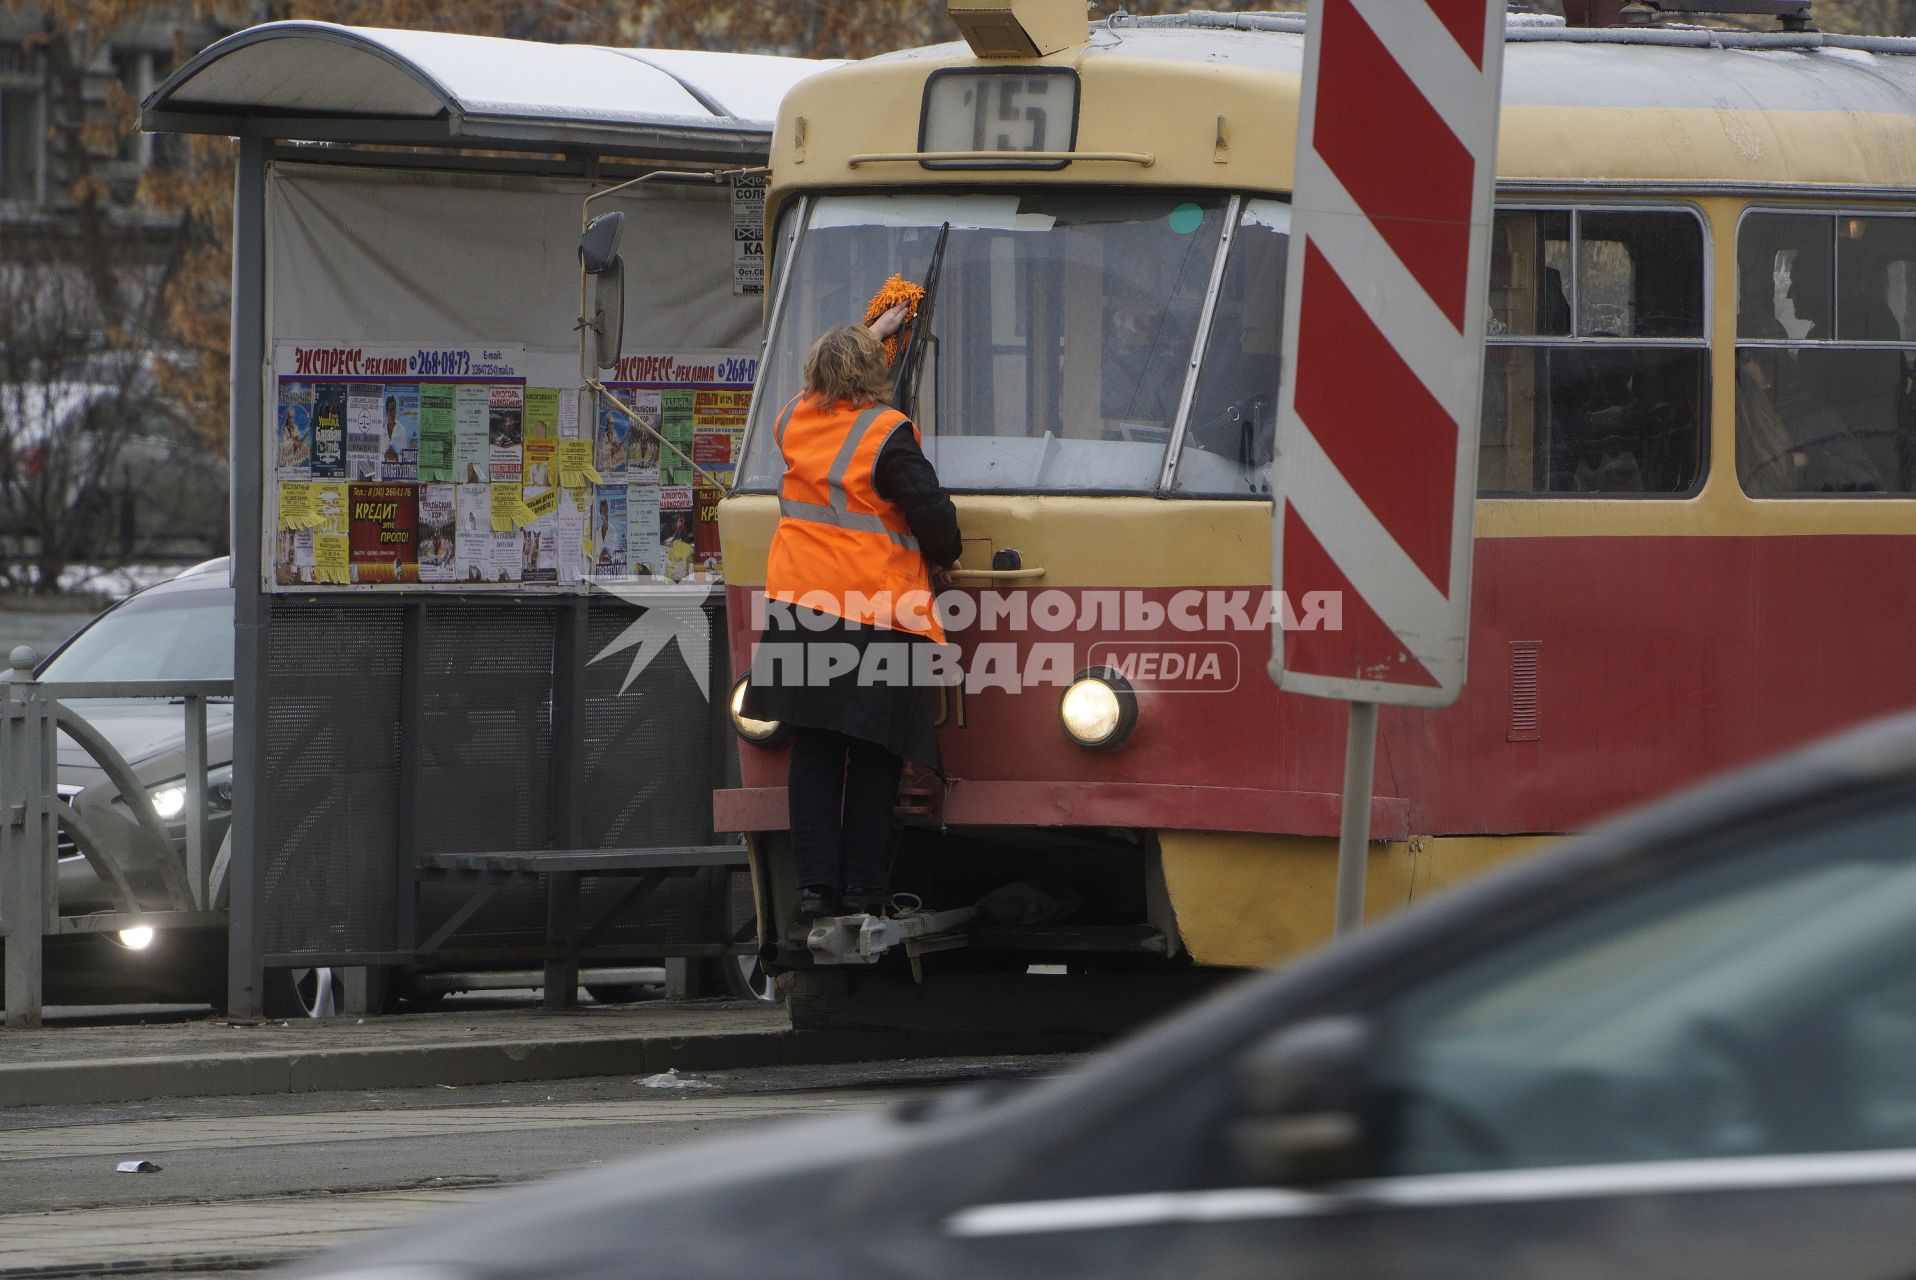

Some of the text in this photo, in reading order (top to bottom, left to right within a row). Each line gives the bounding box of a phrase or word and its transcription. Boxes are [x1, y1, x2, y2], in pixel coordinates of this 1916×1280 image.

[963, 79, 1049, 152] 15
[725, 357, 758, 382] 268-0
[355, 503, 398, 523] КРЕДИТ
[380, 532, 409, 542] ПРОСТО!
